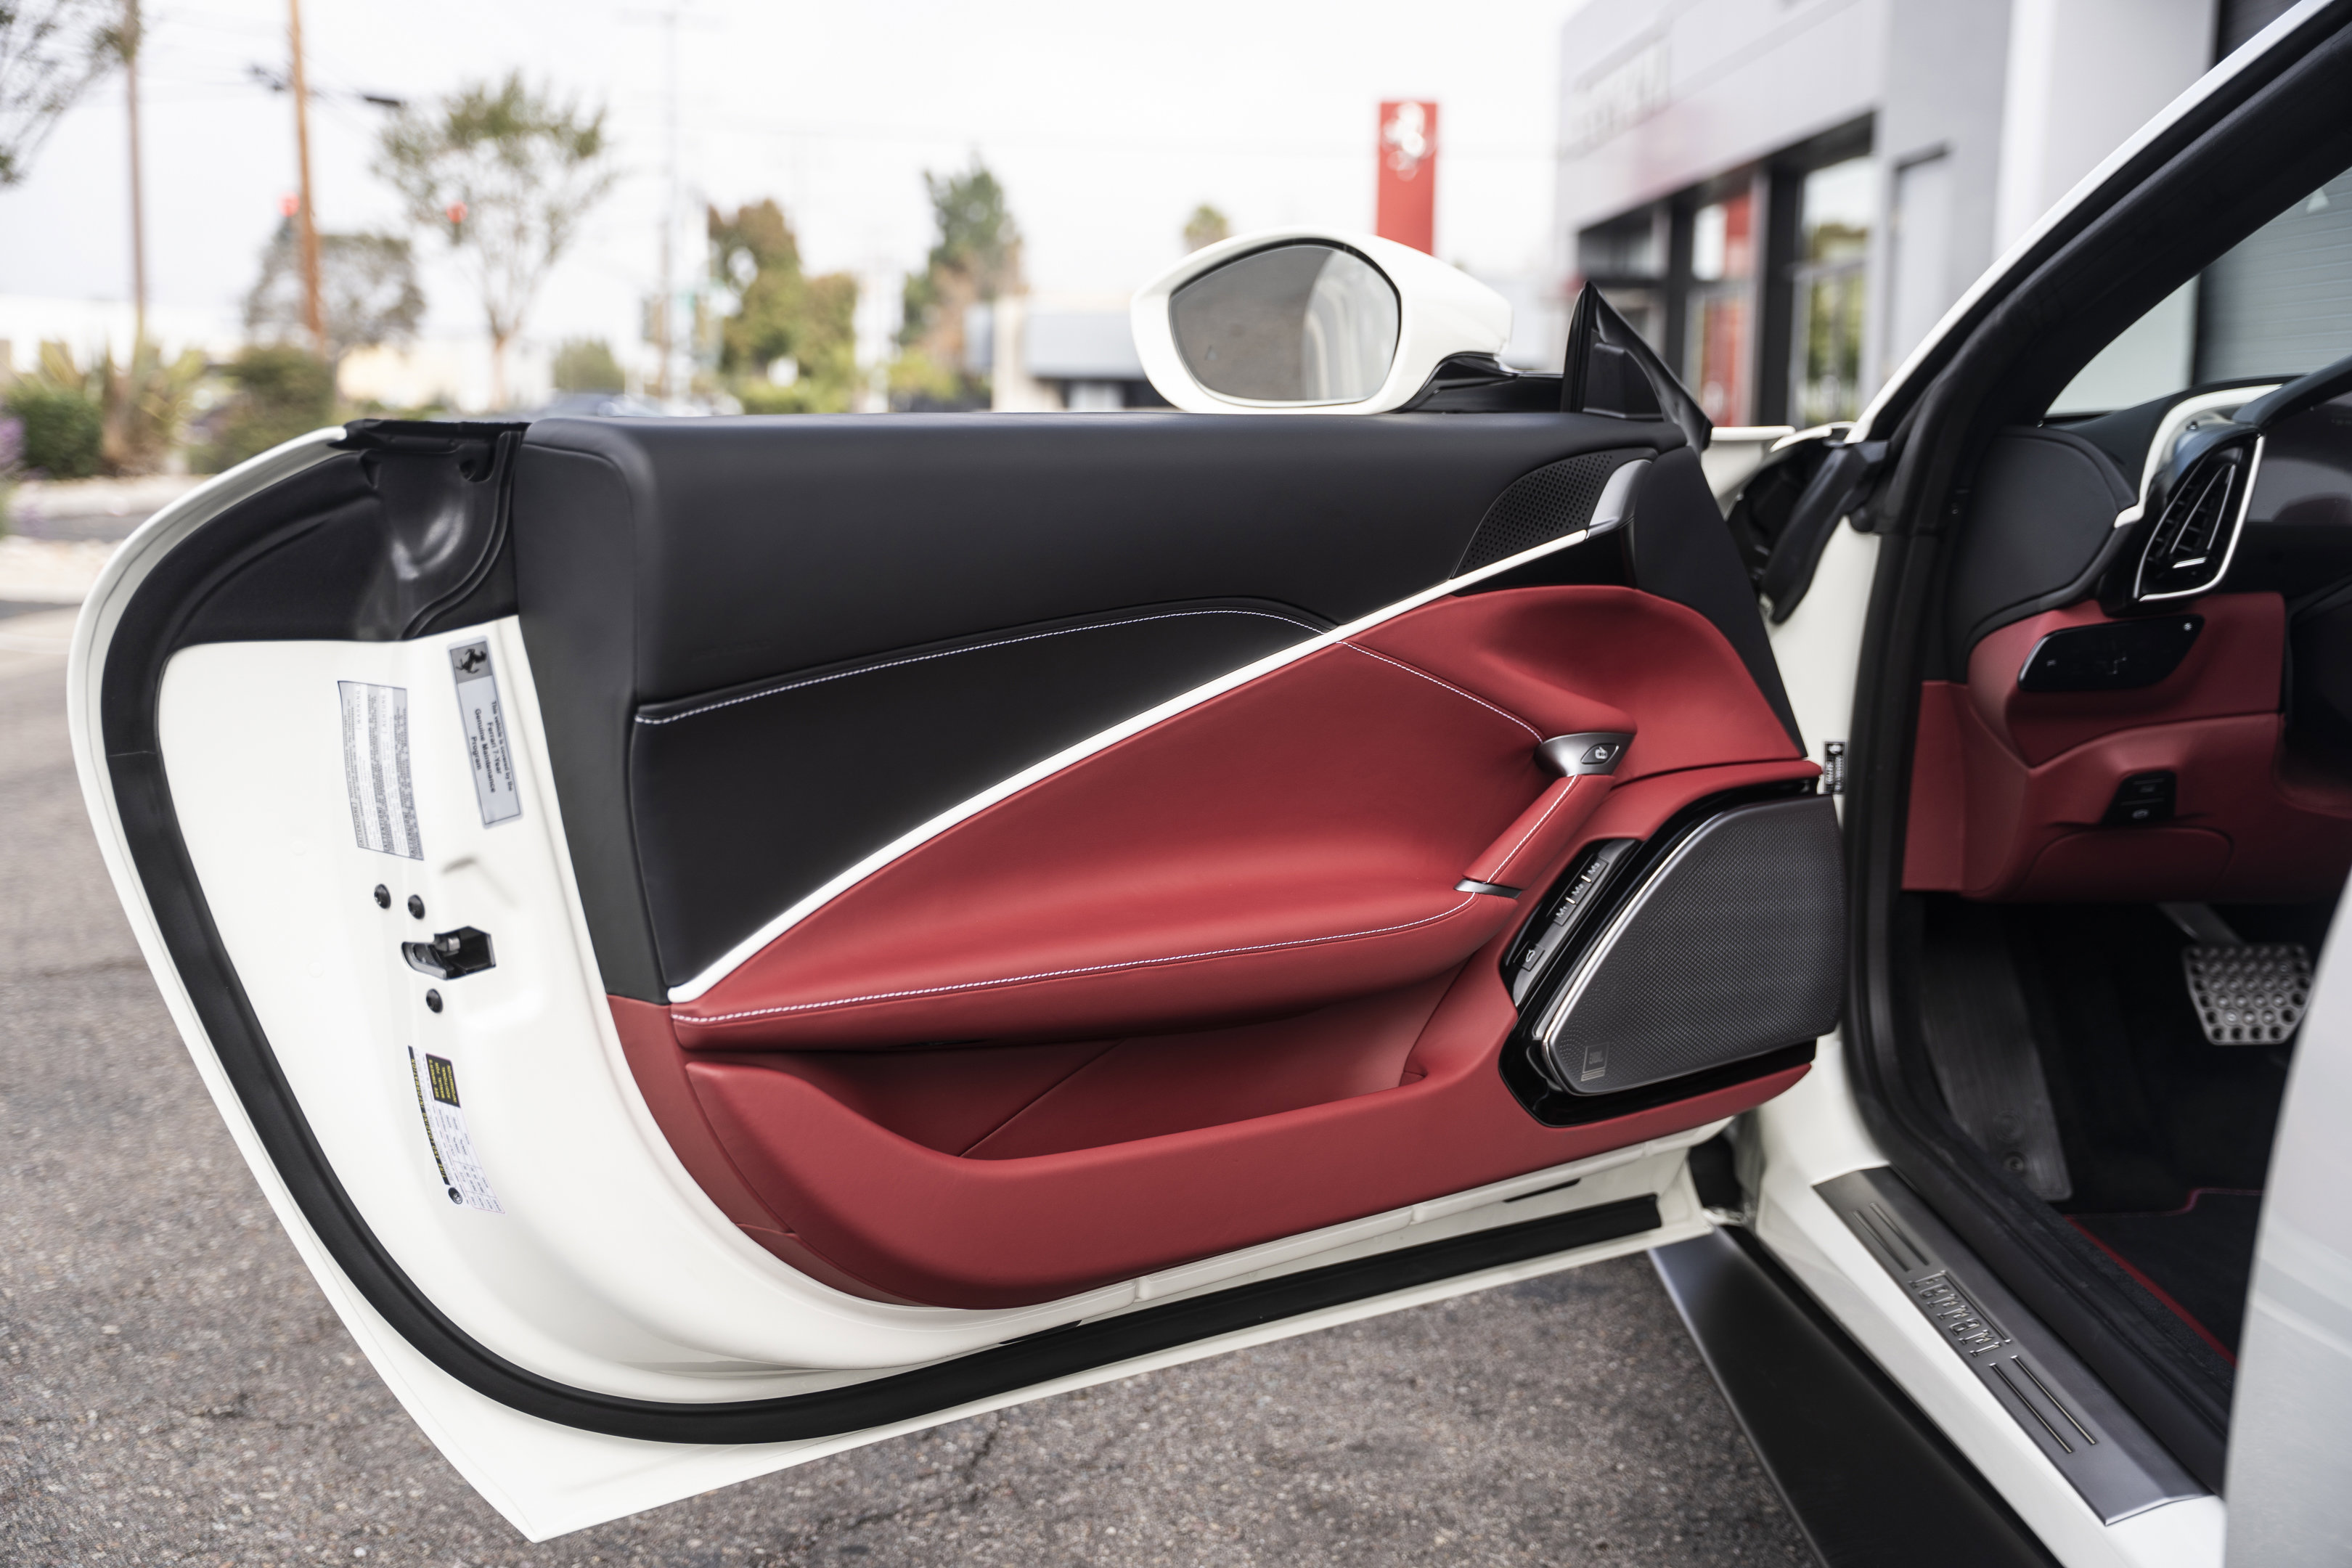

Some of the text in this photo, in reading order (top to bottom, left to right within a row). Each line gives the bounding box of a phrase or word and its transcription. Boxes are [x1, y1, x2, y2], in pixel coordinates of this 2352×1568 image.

[470, 736, 482, 770] Program
[475, 709, 496, 792] Genuine Maintenance
[486, 722, 502, 774] Ferrari 7-Year
[500, 746, 510, 770] covered
[505, 771, 511, 780] by
[1556, 906, 1567, 917] M1
[410, 1058, 425, 1108] INFORMATION
[441, 1067, 451, 1099] ADDITIONAL
[446, 1065, 457, 1102] INFORMATION
[422, 1113, 435, 1143] LOADING
[438, 1163, 446, 1178] TIRE
[1908, 1270, 2001, 1357] Ferrari
